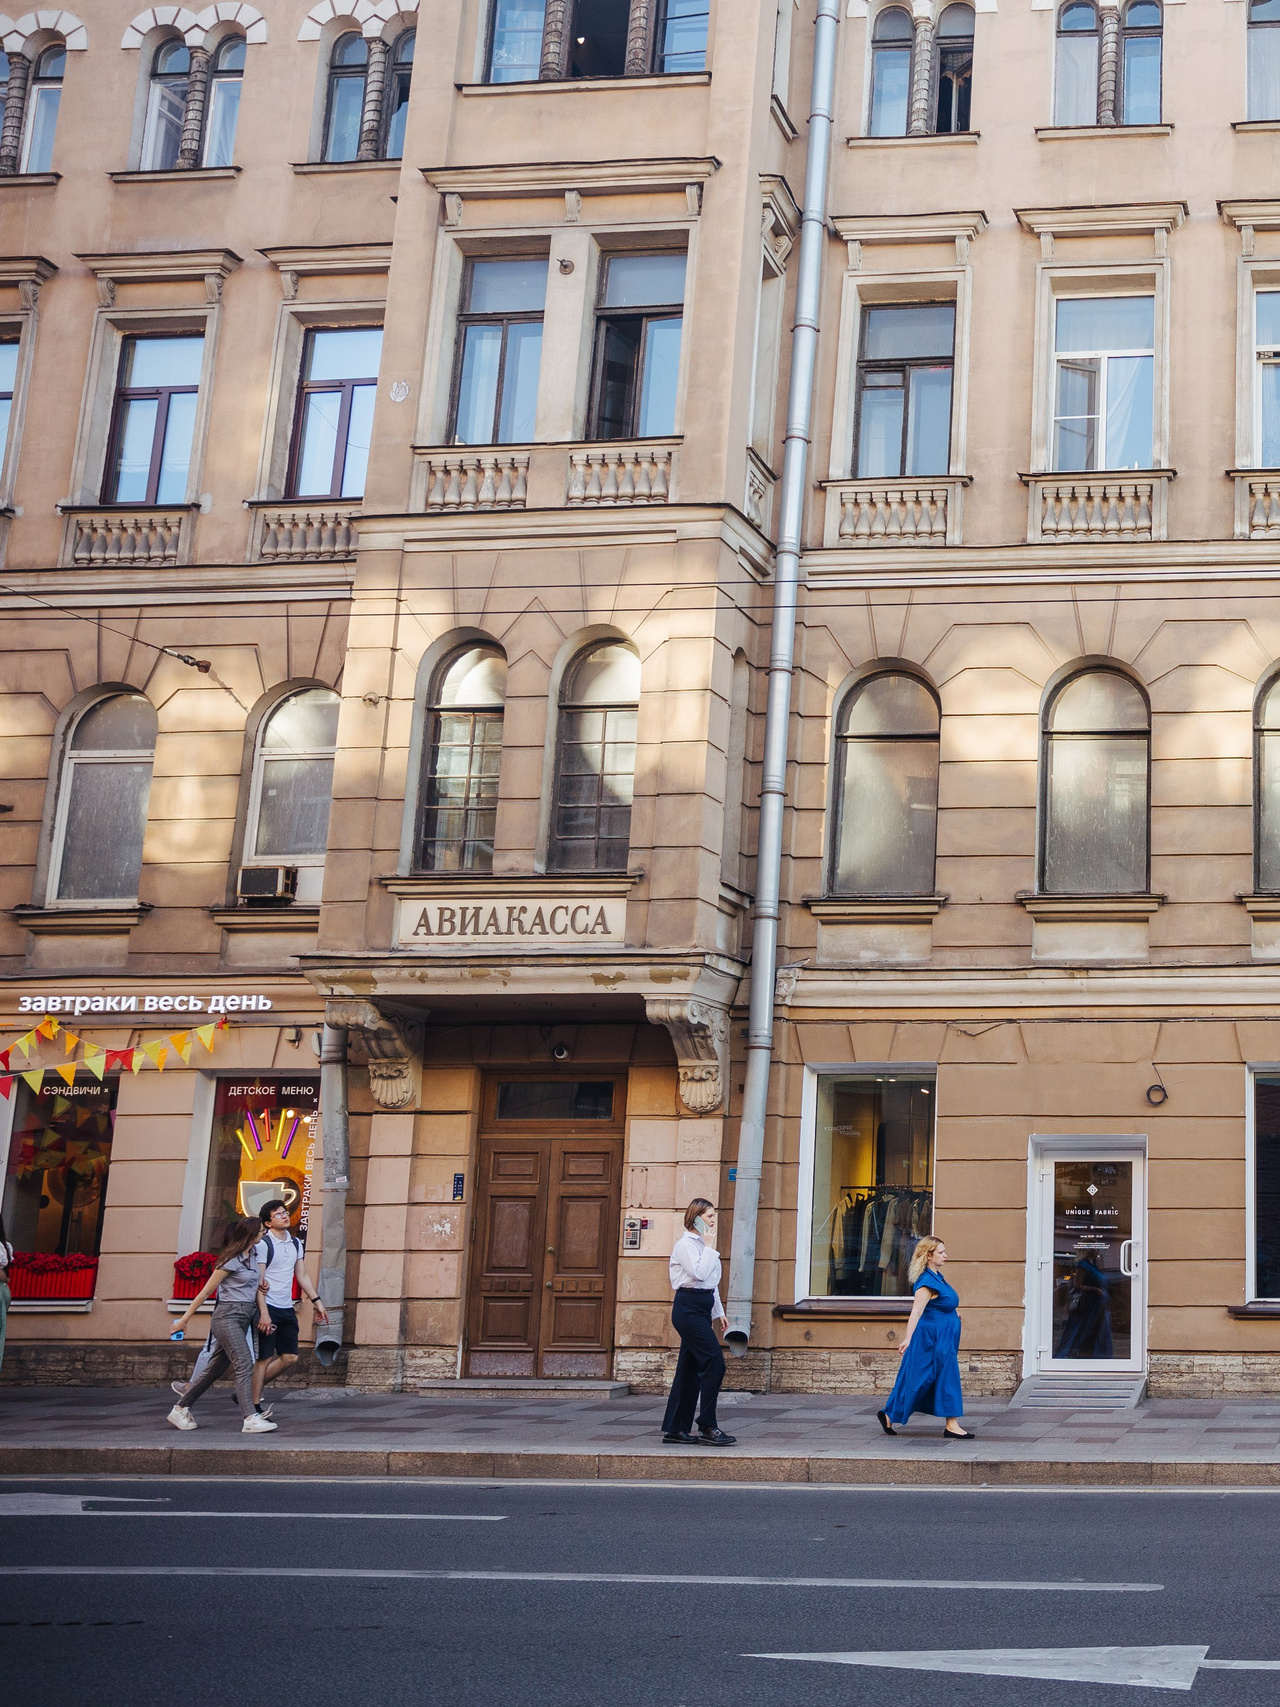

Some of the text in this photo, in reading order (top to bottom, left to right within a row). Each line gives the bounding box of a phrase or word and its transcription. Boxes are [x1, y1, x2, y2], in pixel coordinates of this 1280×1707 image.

[412, 905, 612, 936] АВИАКАССА
[18, 995, 272, 1016] завтраки весь день
[43, 1086, 101, 1096] СЭНДВИЧИ
[228, 1086, 314, 1096] ДЕТСКОЕ МЕНЮ
[300, 1110, 318, 1231] ЗАВТРАКИ ВЕСЬ ДЕНЬ
